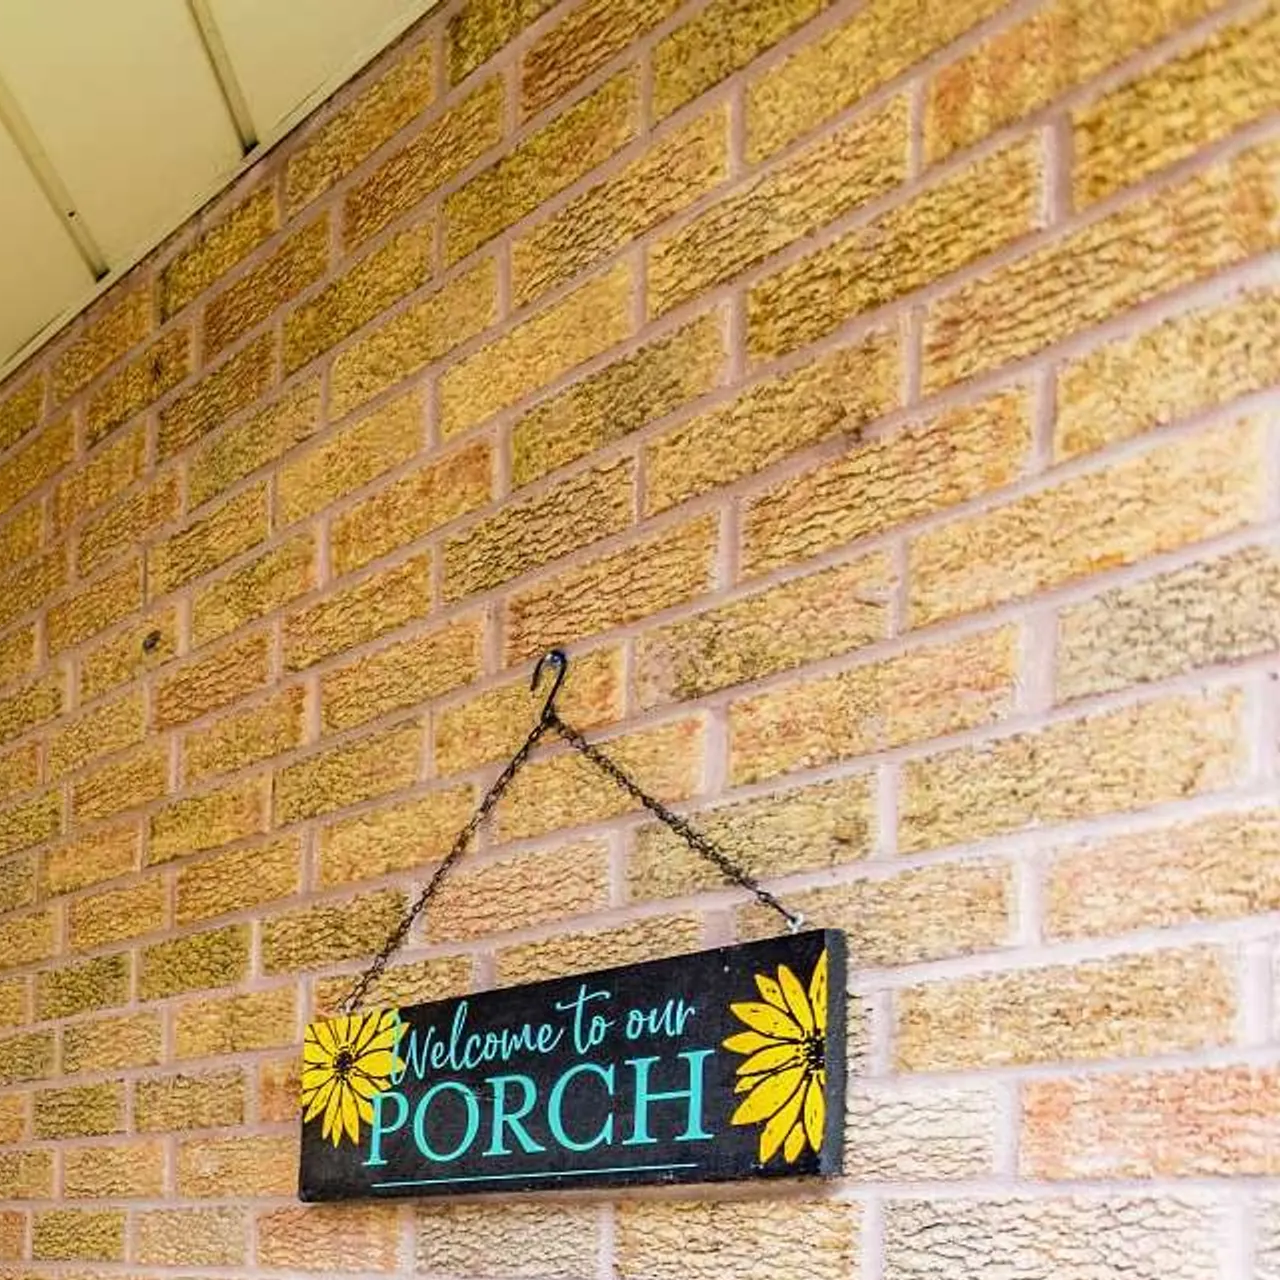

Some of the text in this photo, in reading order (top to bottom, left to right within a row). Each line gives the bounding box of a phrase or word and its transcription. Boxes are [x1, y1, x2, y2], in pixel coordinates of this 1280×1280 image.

[391, 984, 696, 1085] Welcome to our
[361, 1049, 716, 1168] PORCH
